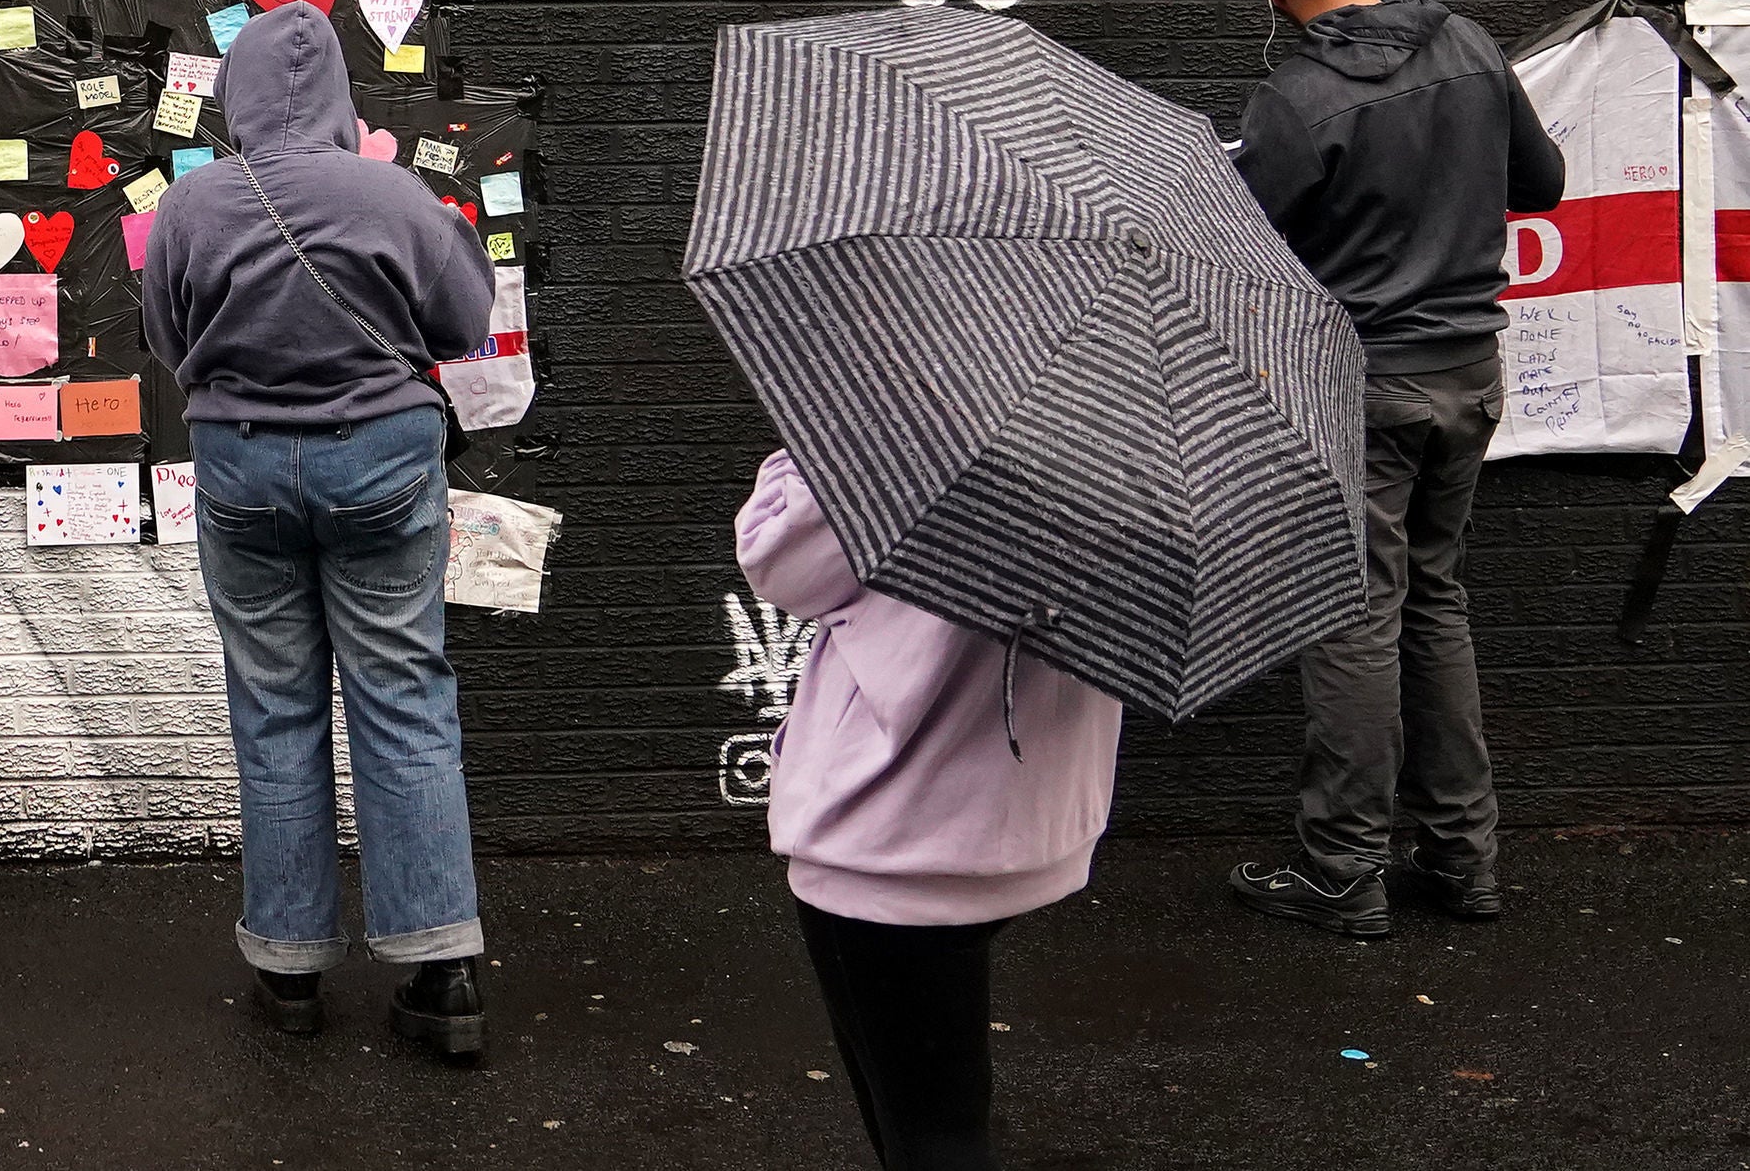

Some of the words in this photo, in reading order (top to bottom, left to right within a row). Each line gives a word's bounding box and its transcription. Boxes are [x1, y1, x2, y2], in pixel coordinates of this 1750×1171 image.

[369, 7, 417, 23] STRENGTH
[80, 81, 104, 92] ROLE
[85, 91, 118, 102] MODEL
[1623, 164, 1655, 181] HERO
[1617, 304, 1637, 320] Say
[1627, 321, 1641, 329] no
[1518, 347, 1557, 364] LADS
[4, 399, 22, 408] Hero
[75, 397, 120, 414] Hero
[107, 467, 127, 478] ONE
